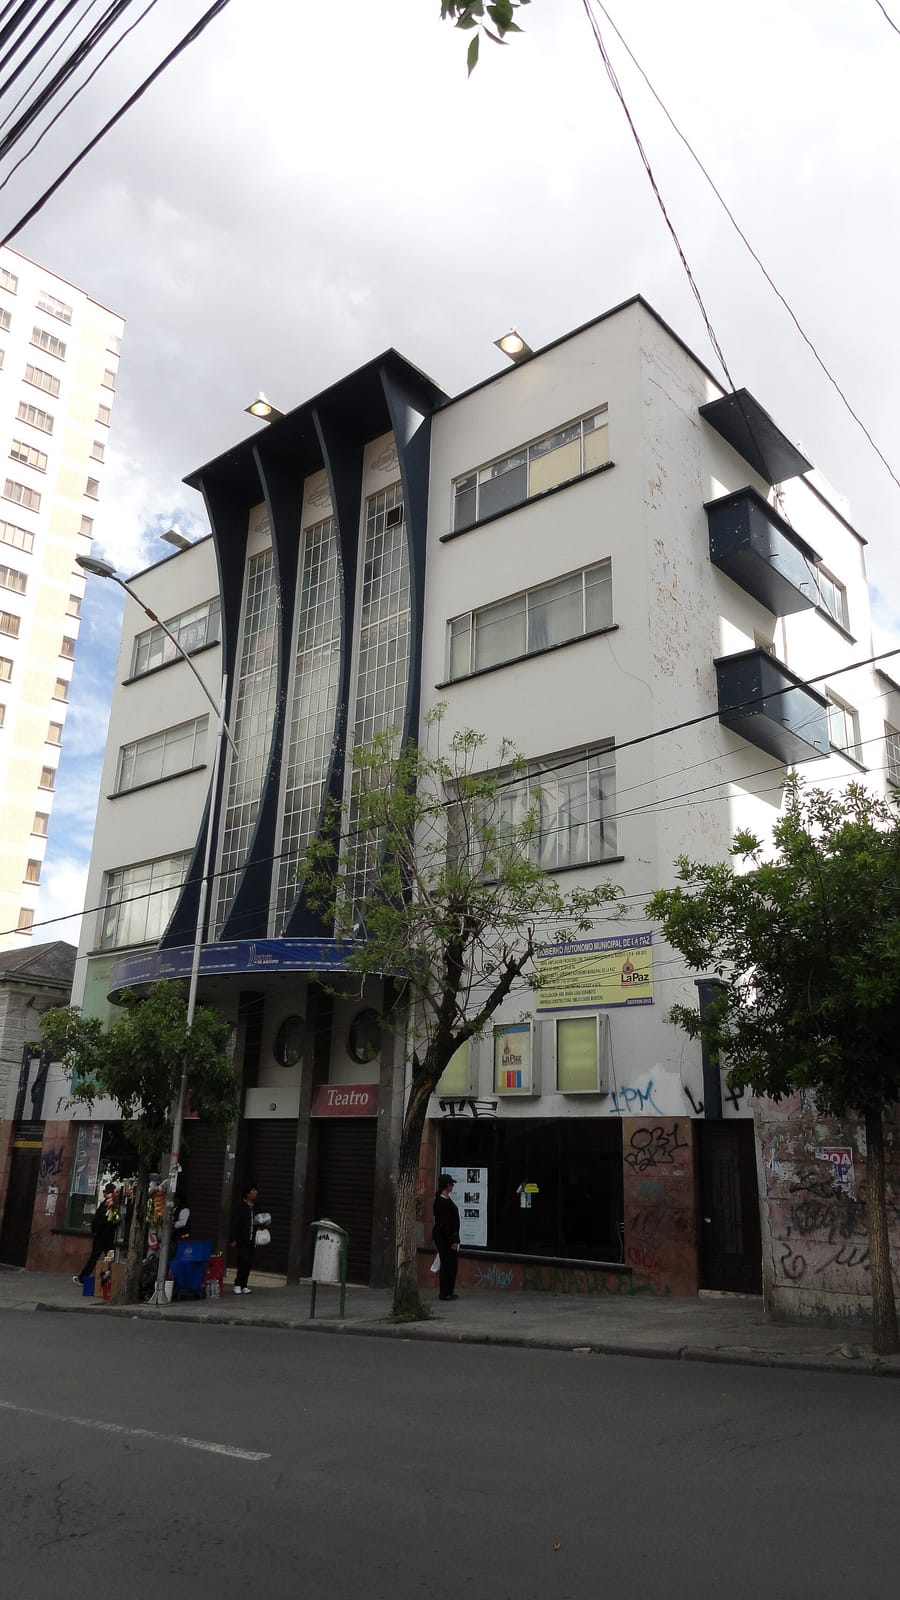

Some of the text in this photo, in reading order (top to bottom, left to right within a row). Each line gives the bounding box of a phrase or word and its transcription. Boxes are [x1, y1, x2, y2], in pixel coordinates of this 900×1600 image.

[565, 942, 593, 953] AUTONOMO
[594, 939, 622, 950] MUNICIPAL
[623, 938, 631, 947] DE
[632, 937, 639, 946] LA
[640, 935, 650, 945] PAZ
[328, 1089, 369, 1106] Teatro
